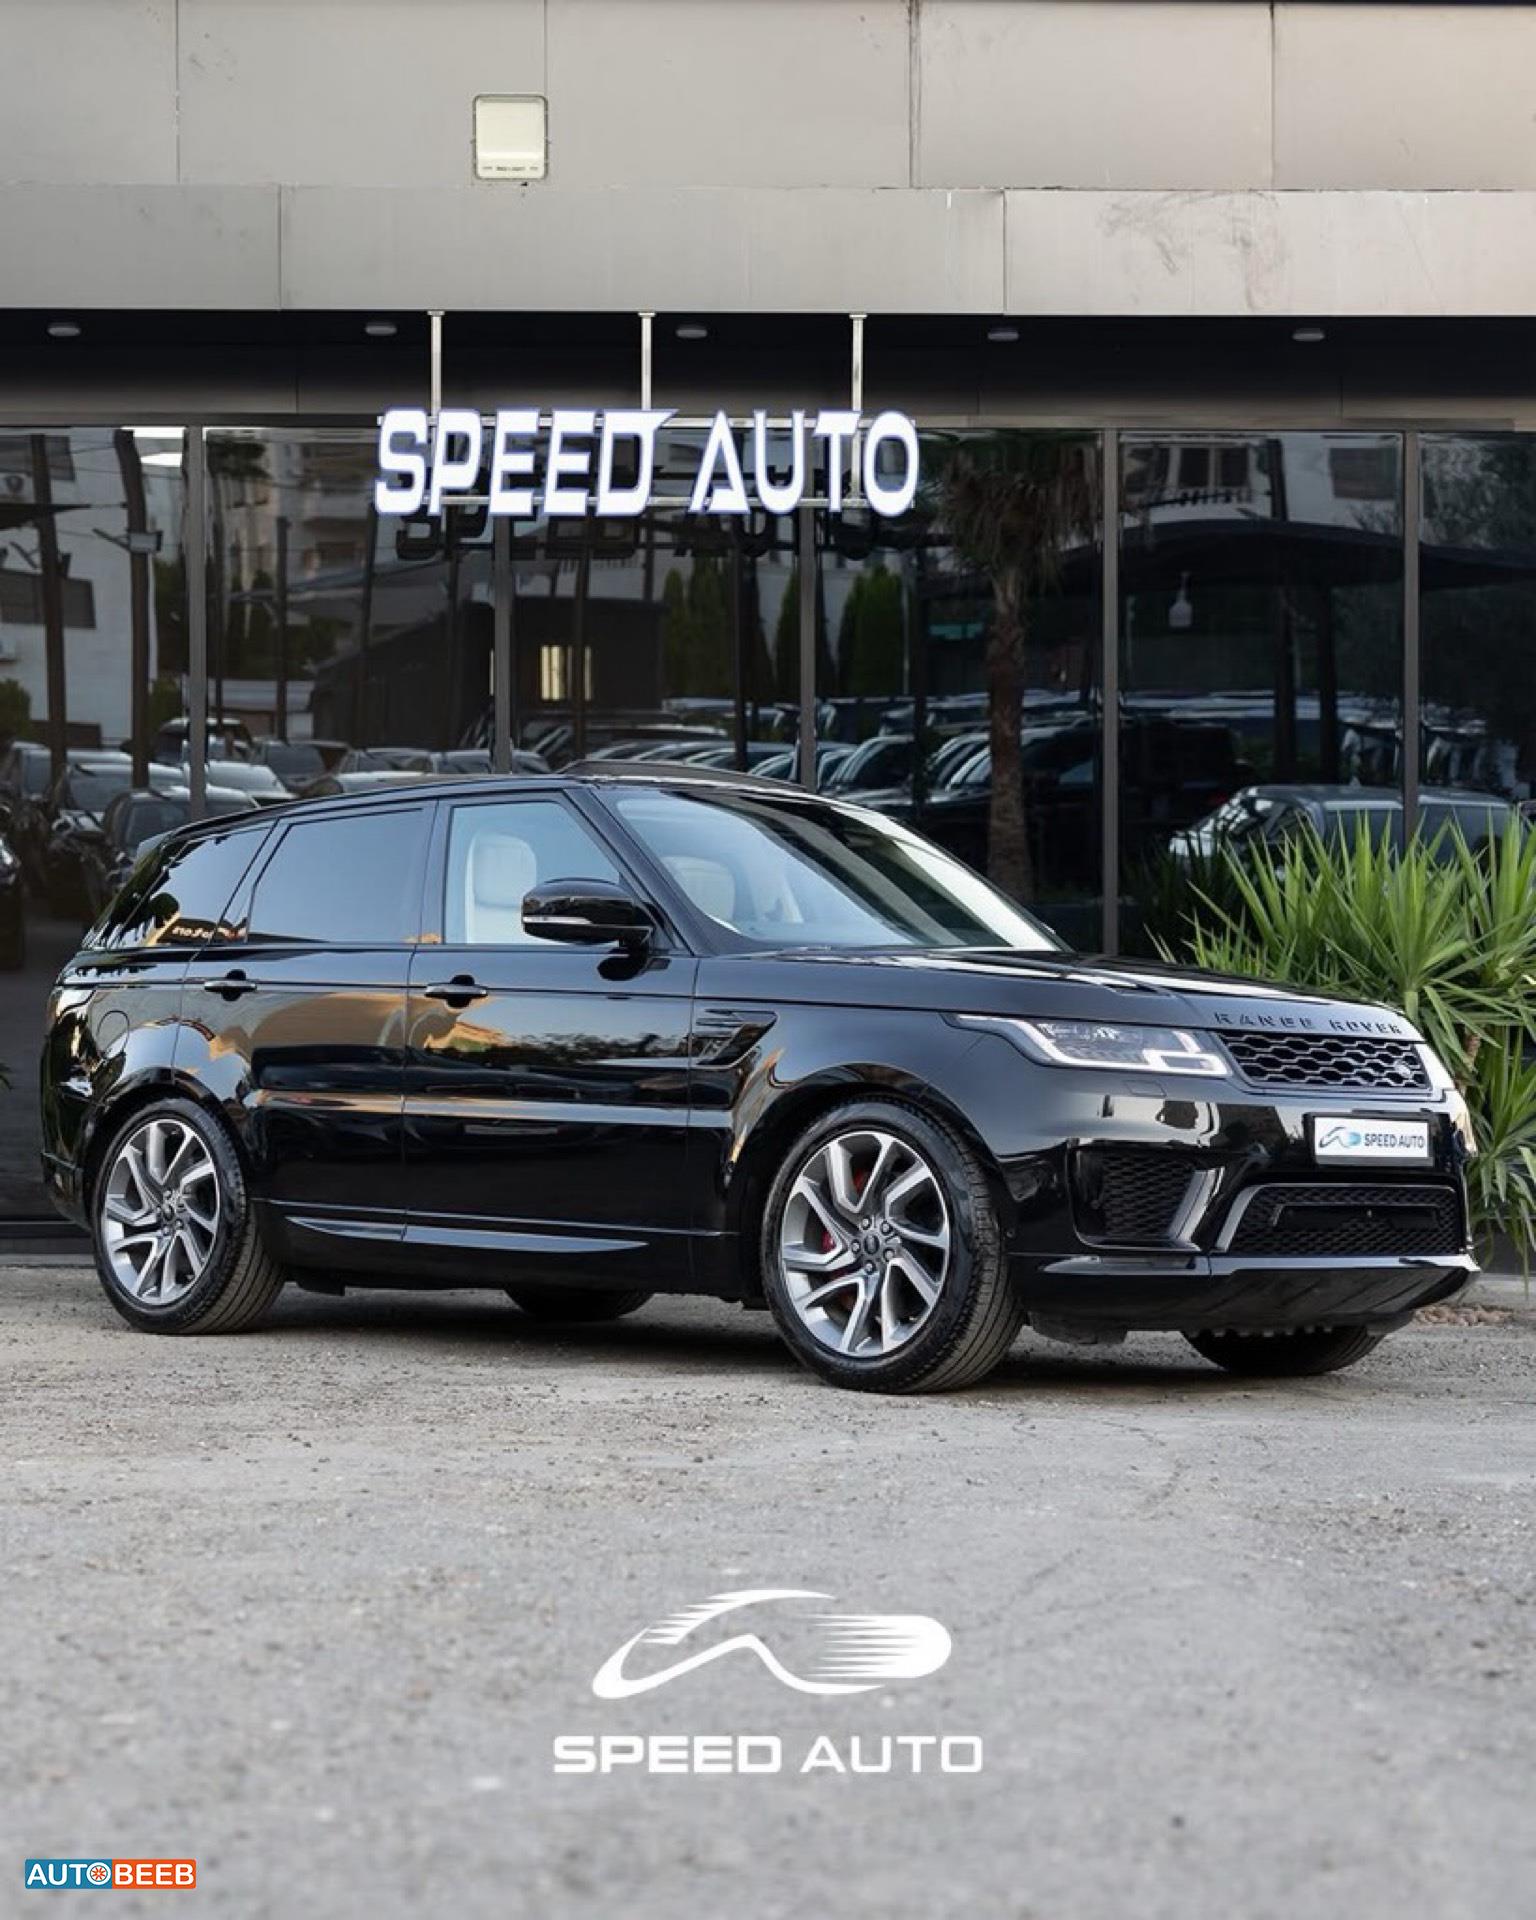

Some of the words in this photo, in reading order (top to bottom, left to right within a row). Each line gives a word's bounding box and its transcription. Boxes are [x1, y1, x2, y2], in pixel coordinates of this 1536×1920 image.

[374, 408, 678, 517] SPEED
[688, 408, 920, 518] AUTO
[1213, 1011, 1315, 1029] RANGE
[1328, 1018, 1402, 1035] ROVER
[1364, 1133, 1397, 1148] SPEED
[1399, 1134, 1425, 1149] AUTO
